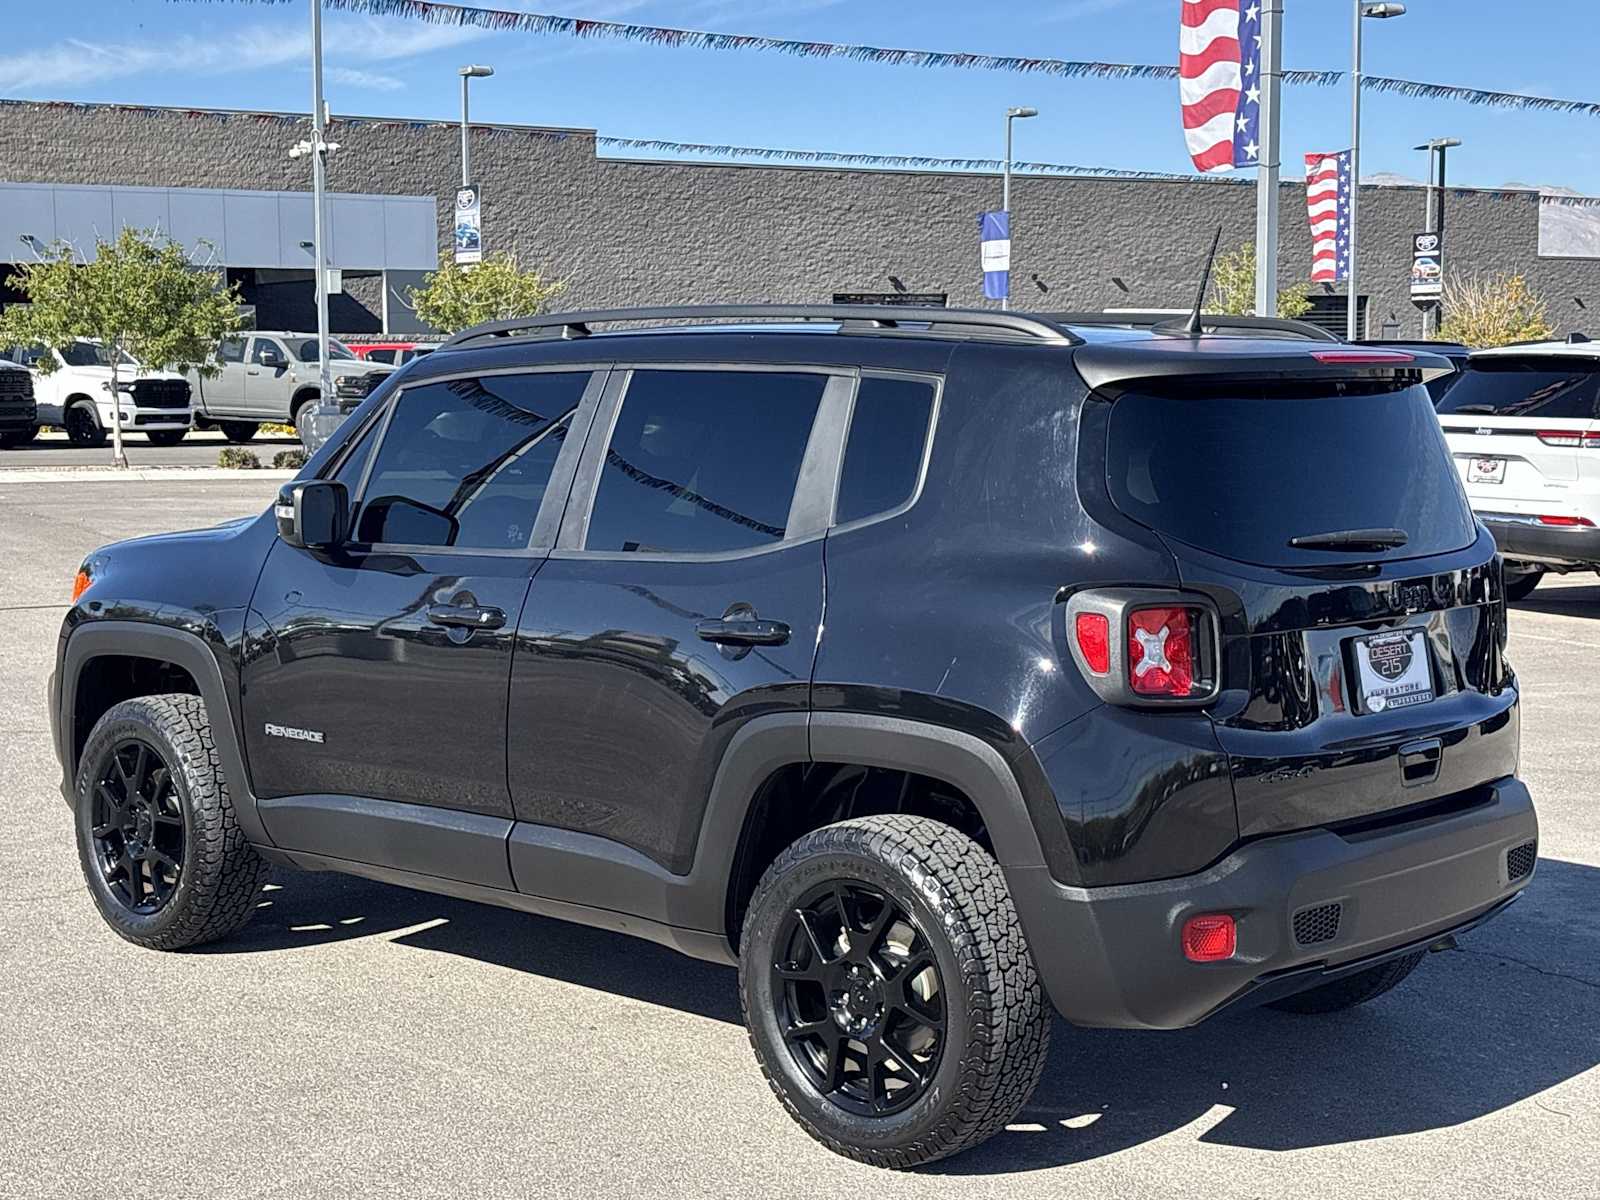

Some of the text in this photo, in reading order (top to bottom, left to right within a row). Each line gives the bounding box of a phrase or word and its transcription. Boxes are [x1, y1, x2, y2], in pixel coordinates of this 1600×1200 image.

[1371, 643, 1408, 659] DESERT
[1381, 658, 1402, 675] 215
[264, 723, 325, 744] RENEGADE
